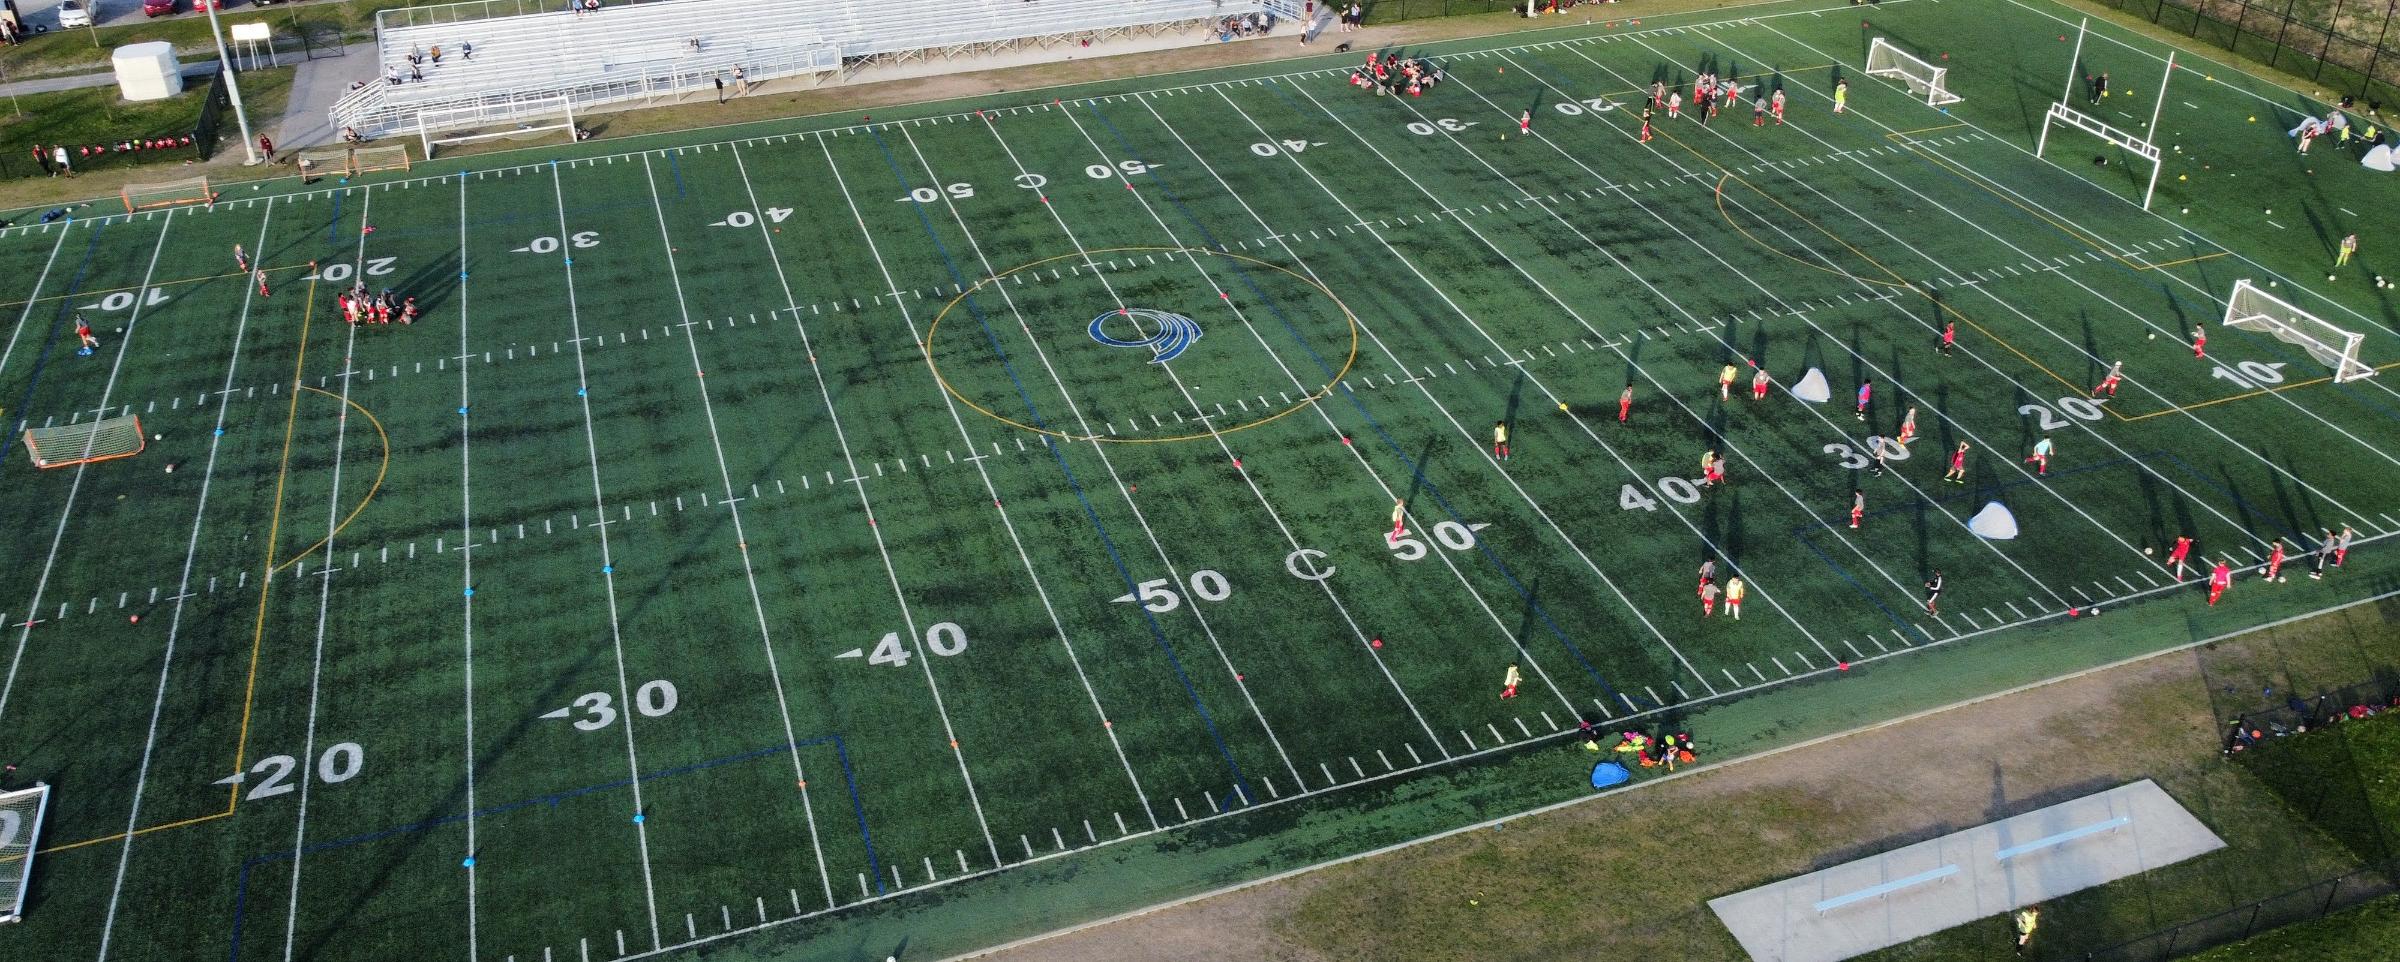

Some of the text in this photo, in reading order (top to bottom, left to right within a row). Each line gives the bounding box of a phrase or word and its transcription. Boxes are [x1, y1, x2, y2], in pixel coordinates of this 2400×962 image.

[1554, 98, 1615, 116] 20
[1406, 118, 1466, 136] 30
[1250, 139, 1308, 157] 40
[1014, 173, 1047, 189] C
[1085, 160, 1147, 179] 50
[911, 182, 975, 203] 50
[726, 207, 794, 228] 40
[530, 231, 600, 254] 30
[322, 256, 397, 282] 20
[100, 287, 170, 312] 10
[2212, 360, 2284, 389] 10
[2018, 396, 2104, 431] 20
[1823, 435, 1910, 469] 30
[1619, 476, 1701, 512] 40
[1383, 520, 1475, 561] 50
[1285, 548, 1336, 581] C
[1137, 569, 1231, 613] 50
[868, 622, 968, 668] 40
[572, 679, 678, 731] 30
[245, 742, 364, 801] 20
